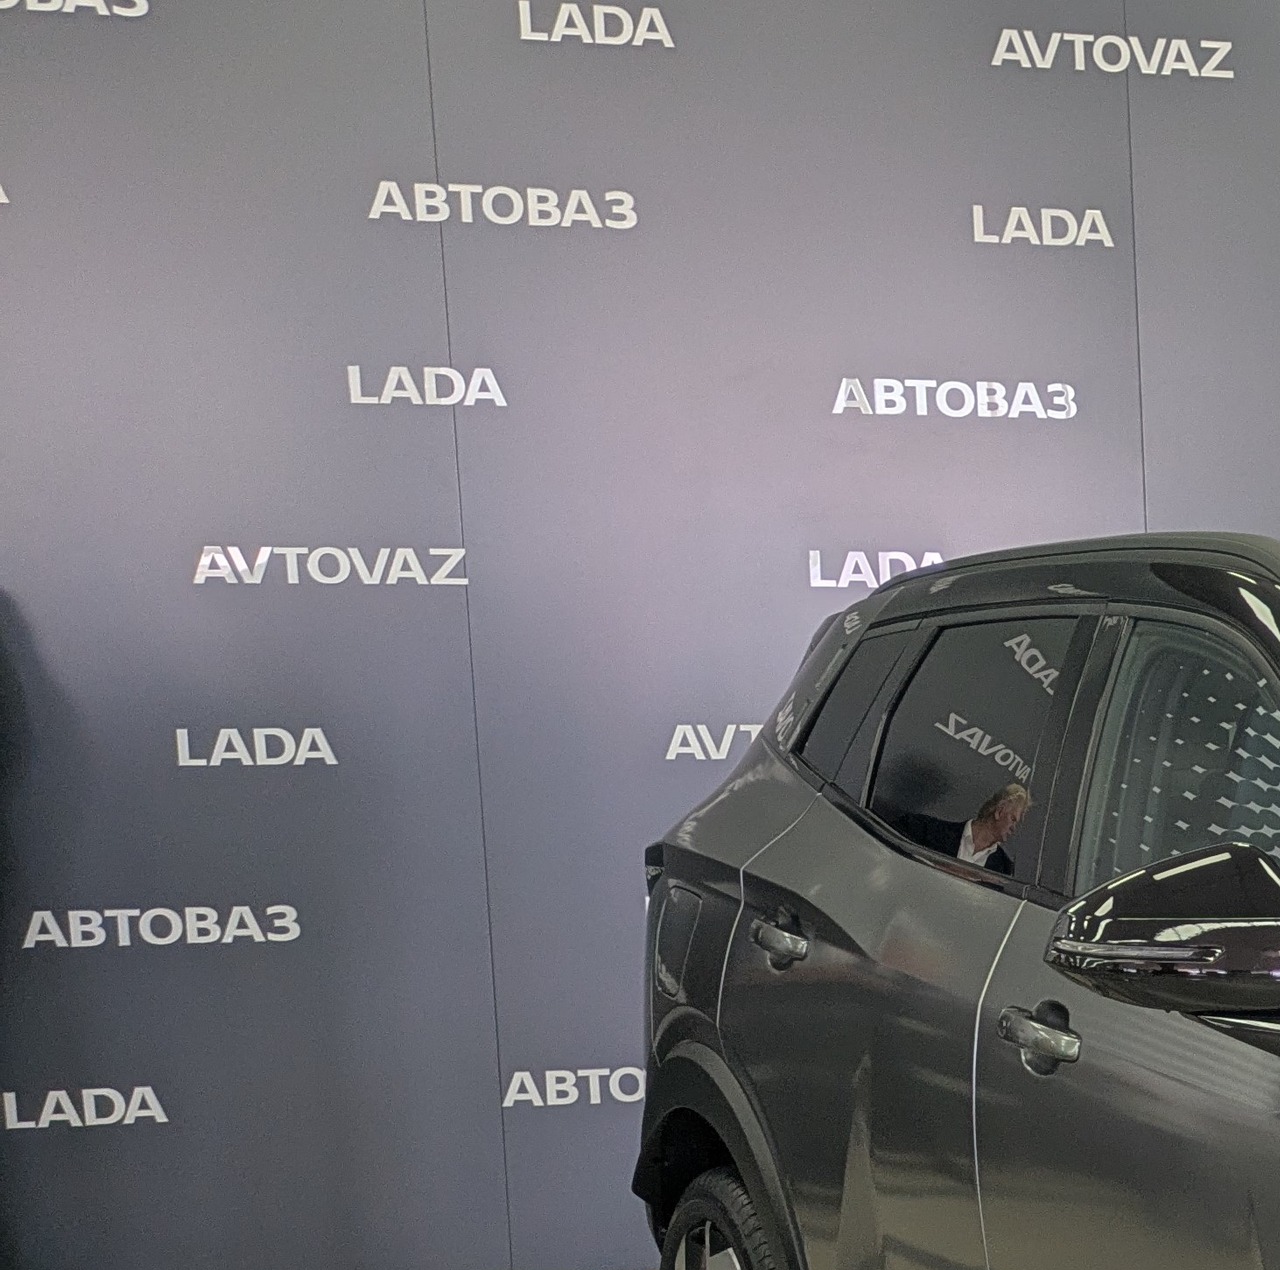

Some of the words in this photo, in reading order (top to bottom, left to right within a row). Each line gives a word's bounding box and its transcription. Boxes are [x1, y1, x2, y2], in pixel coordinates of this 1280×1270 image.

[518, 0, 675, 48] LADA
[991, 28, 1235, 79] AVTOVAZ
[368, 180, 638, 229] АВТОВАЗ
[972, 204, 1115, 247] LADA
[347, 365, 508, 408] LADA
[831, 377, 1079, 420] АВТОВАЗ
[193, 545, 469, 586] AVTOVAZ
[176, 727, 339, 766] LADA
[23, 904, 302, 949] АВТОВАЗ
[3, 1085, 169, 1130] LADA
[502, 1066, 646, 1108] АВТО
